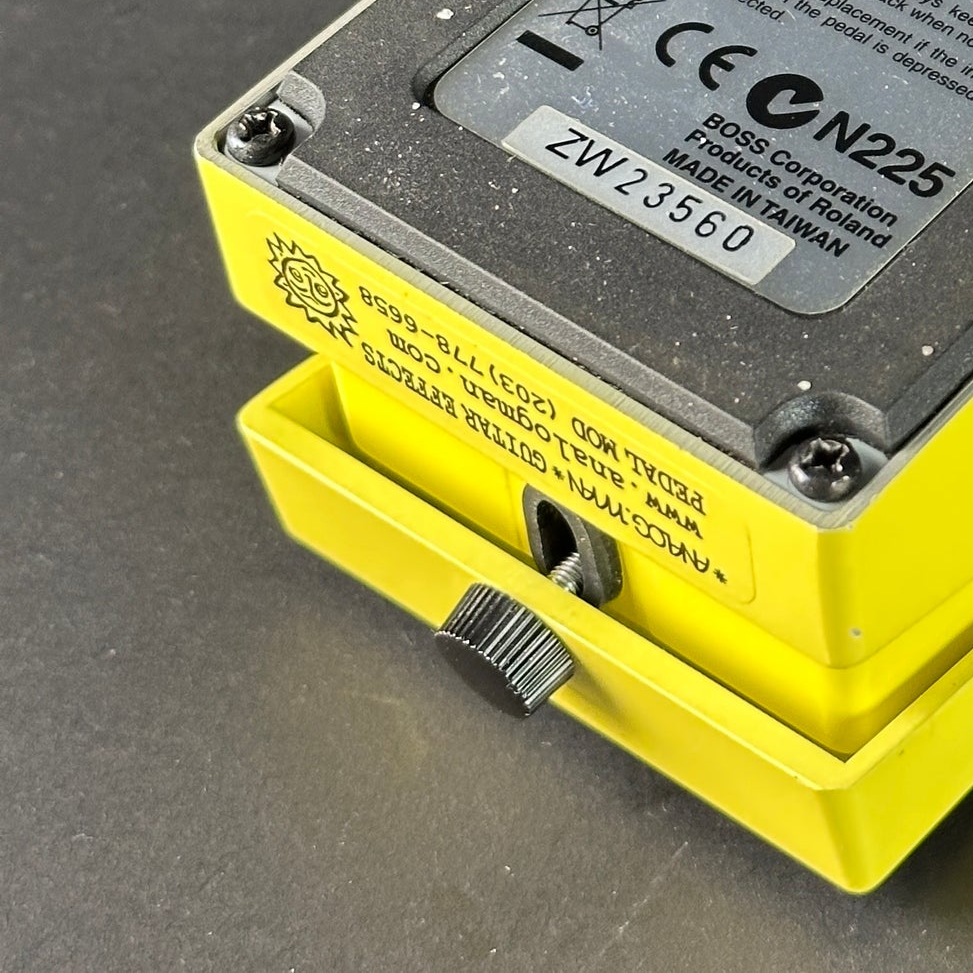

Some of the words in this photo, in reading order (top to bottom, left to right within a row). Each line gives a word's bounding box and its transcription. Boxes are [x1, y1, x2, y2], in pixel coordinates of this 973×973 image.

[793, 0, 822, 19] the
[820, 16, 874, 45] pedal
[872, 39, 890, 54] is
[909, 7, 955, 37] when
[913, 38, 931, 52] if
[929, 47, 958, 68] the
[683, 128, 782, 189] Products
[782, 185, 814, 204] of
[808, 196, 893, 249] Roland
[701, 112, 770, 155] BOSS
[769, 149, 898, 228] Corporation
[812, 110, 957, 198] N225
[662, 147, 735, 194] MADE
[730, 185, 762, 209] IN
[759, 199, 850, 258] TAIWAN
[360, 341, 459, 419] EFFECTS
[386, 328, 704, 540] www.analogman.com
[460, 403, 548, 474] GUITAR
[571, 416, 620, 463] MOD
[624, 447, 707, 516] PEDAL
